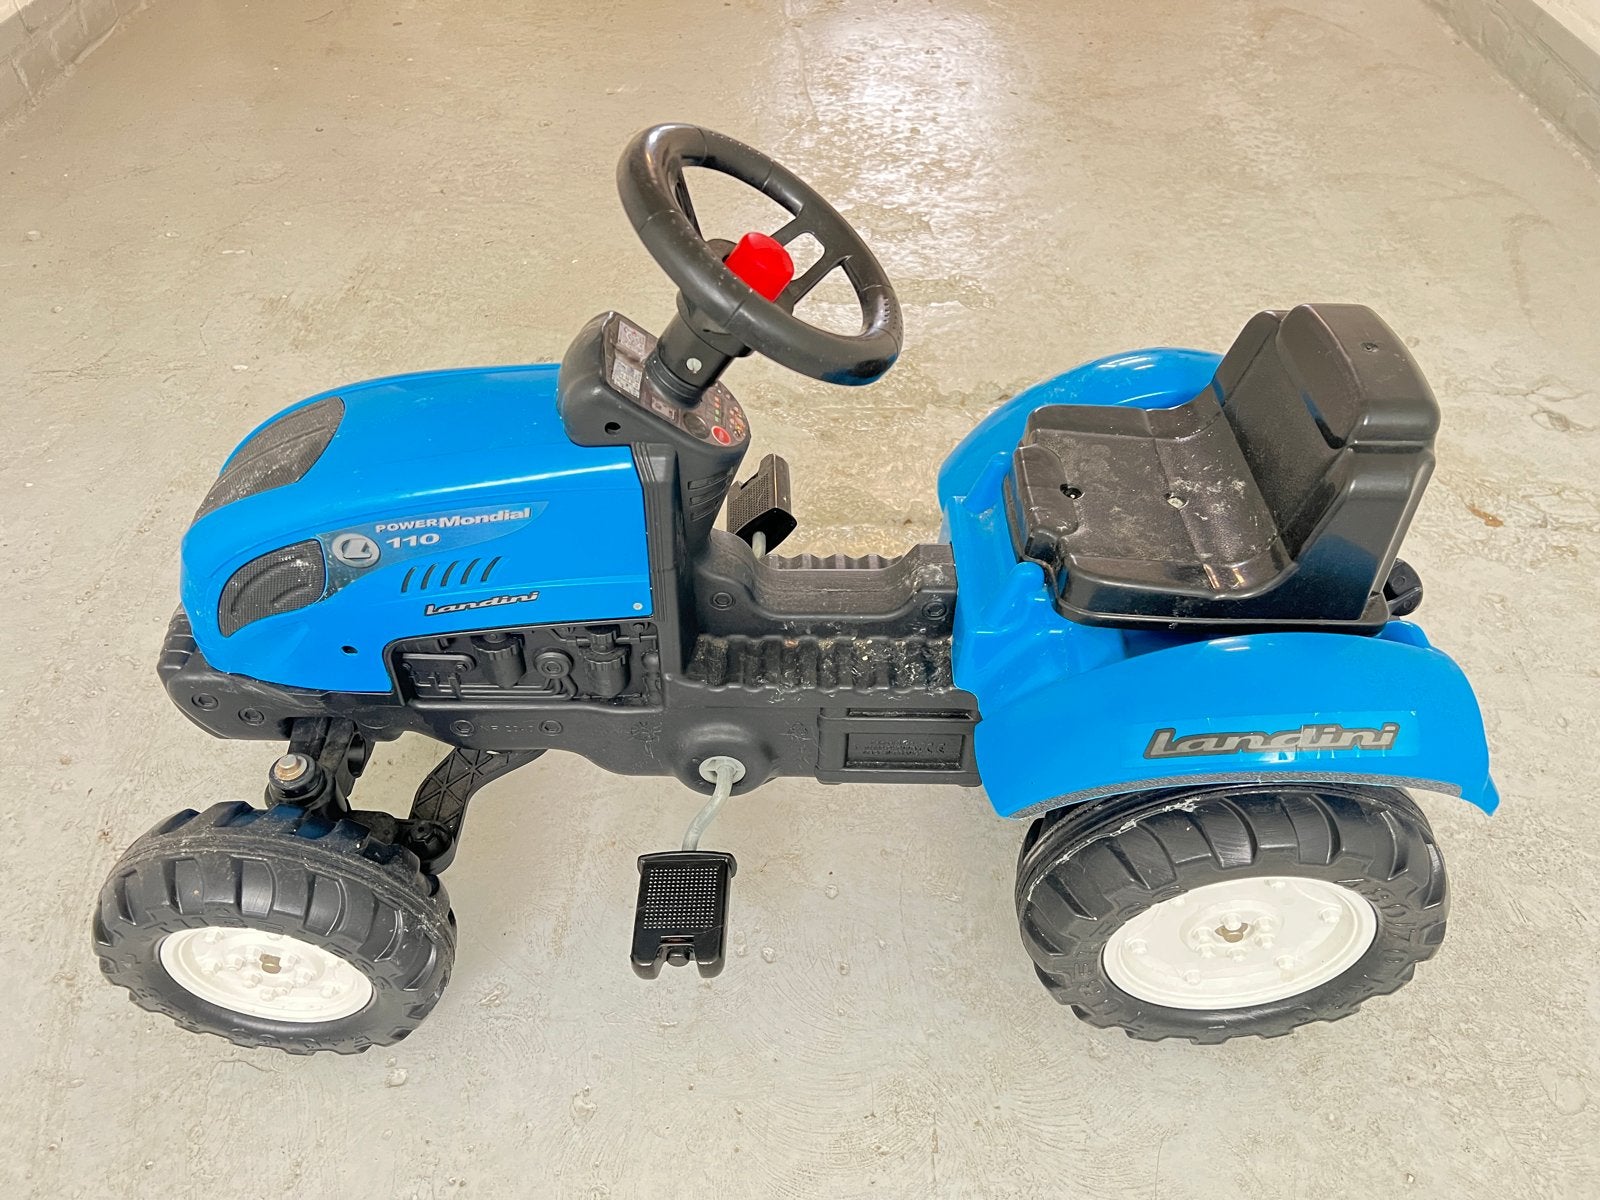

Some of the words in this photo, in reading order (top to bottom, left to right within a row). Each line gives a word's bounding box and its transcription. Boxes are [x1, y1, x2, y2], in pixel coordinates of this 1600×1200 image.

[386, 533, 441, 549] 110
[425, 591, 540, 616] Landini
[1145, 724, 1399, 758] Landini
